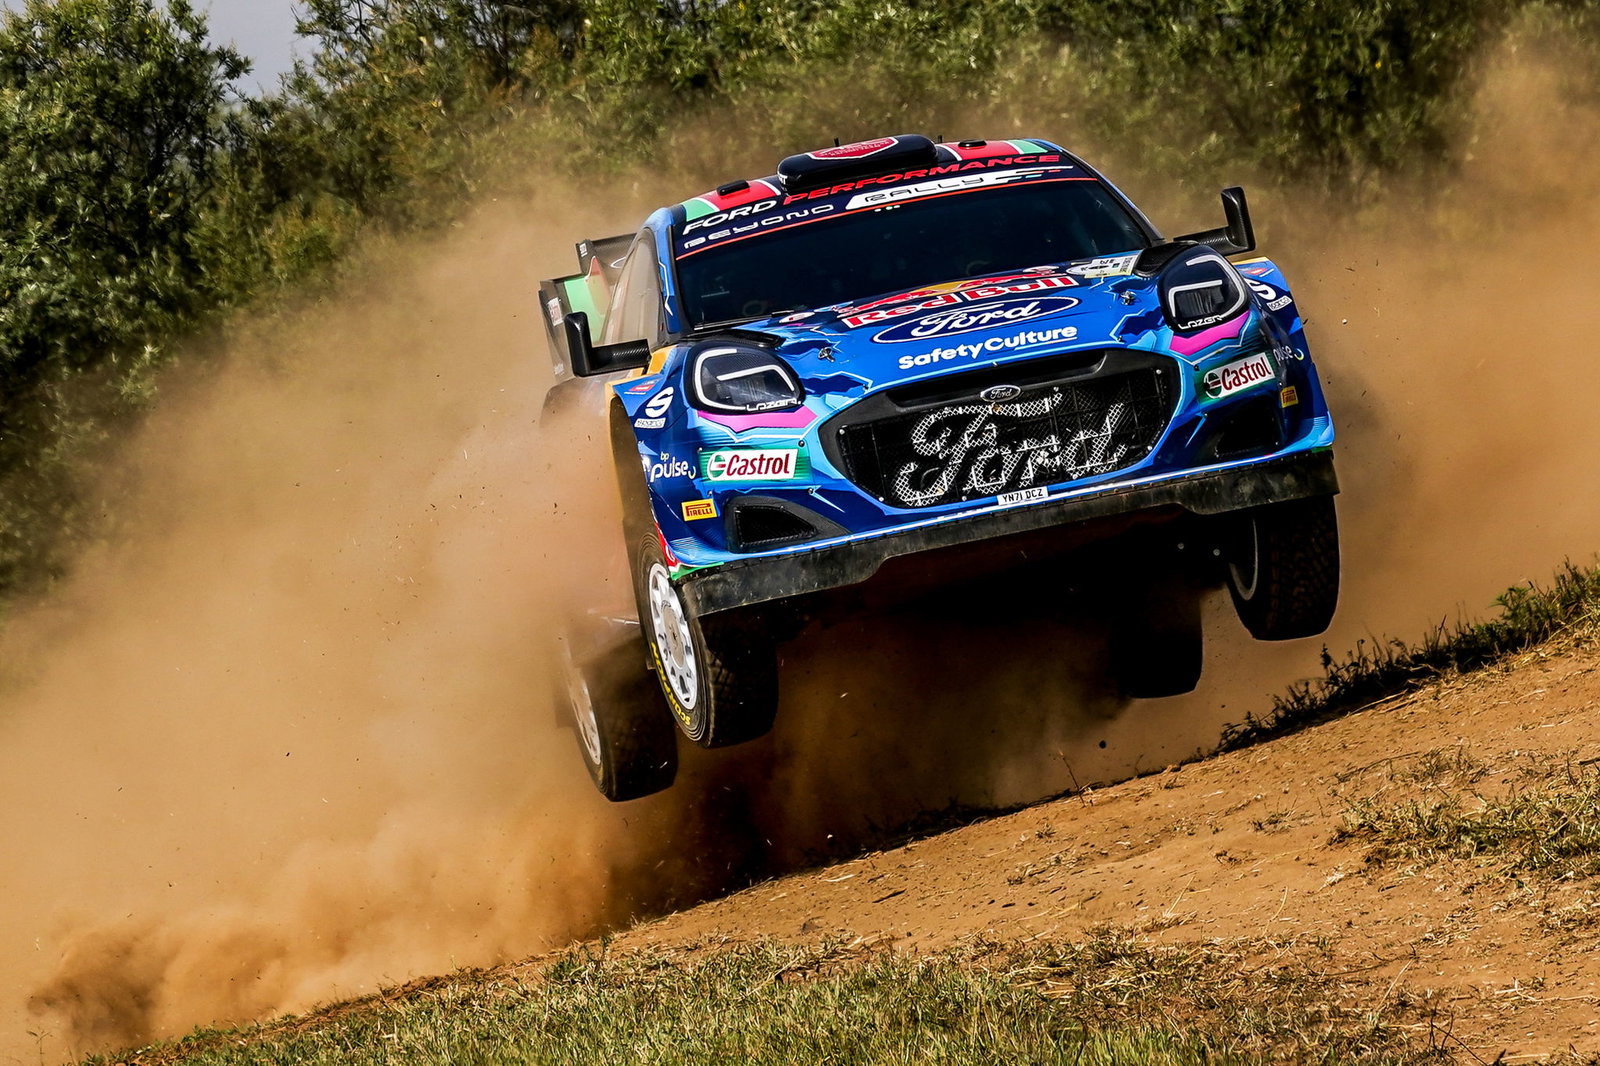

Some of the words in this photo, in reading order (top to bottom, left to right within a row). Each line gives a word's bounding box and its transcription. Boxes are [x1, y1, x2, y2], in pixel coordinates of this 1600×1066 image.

[682, 200, 777, 236] FORD
[783, 154, 1059, 206] PERFORMANCE
[864, 176, 984, 203] RALLY
[684, 204, 834, 249] BEYOND
[841, 291, 960, 328] Red
[962, 276, 1079, 302] Bull
[911, 302, 1044, 338] Ford
[1178, 314, 1223, 330] LAZER
[898, 325, 1078, 370] SafetyCulture
[1221, 357, 1271, 391] Castrol
[990, 387, 1012, 399] Ford
[660, 451, 669, 462] bp
[892, 388, 1128, 506] Ford
[650, 456, 688, 483] pulse
[727, 453, 790, 476] Castrol
[1002, 491, 1023, 502] YN71
[1025, 488, 1043, 499] DCZ
[685, 503, 713, 516] PIRELLI
